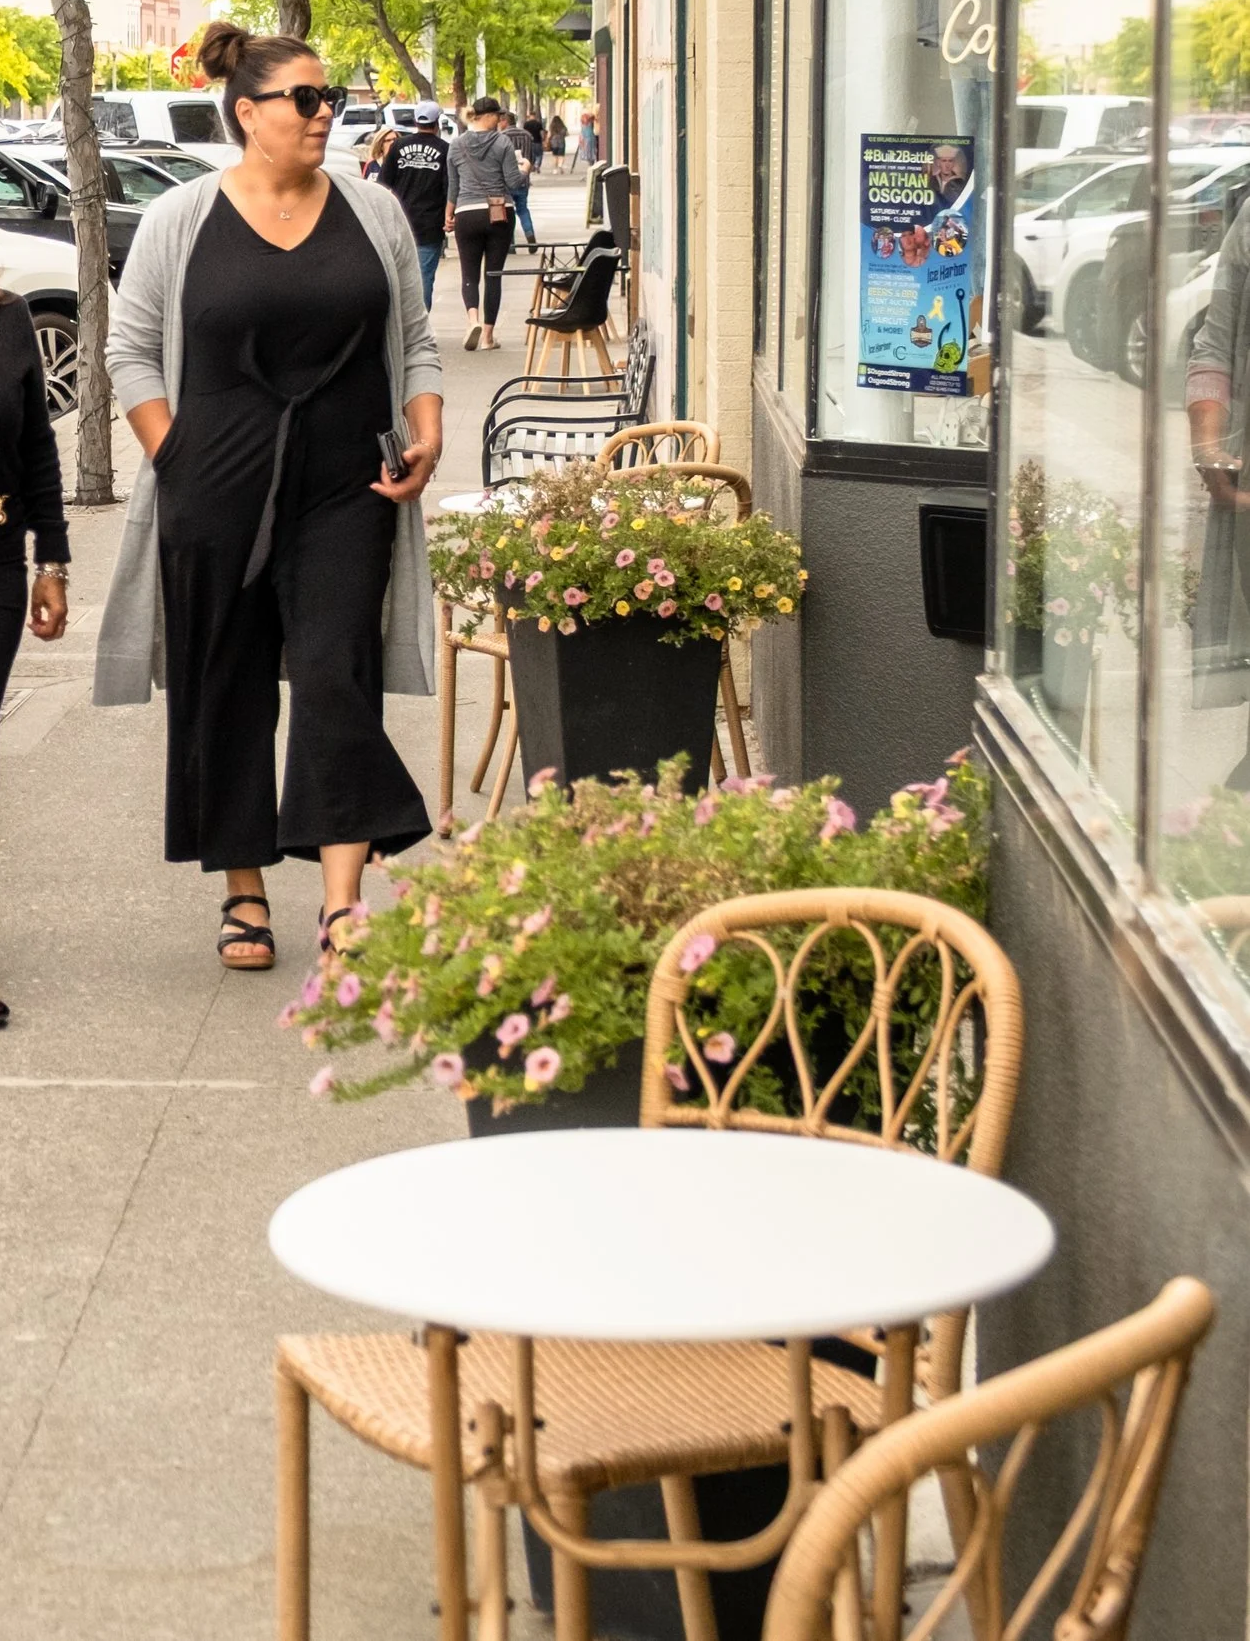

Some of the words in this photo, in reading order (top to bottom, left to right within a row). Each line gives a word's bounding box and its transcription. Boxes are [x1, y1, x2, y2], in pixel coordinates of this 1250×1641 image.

[423, 145, 441, 160] CITY
[863, 148, 935, 164] #Built2Battle
[868, 171, 929, 189] NATHAN
[868, 187, 935, 206] OSGOOD
[893, 216, 911, 224] CLOSE
[940, 263, 968, 281] Harbor
